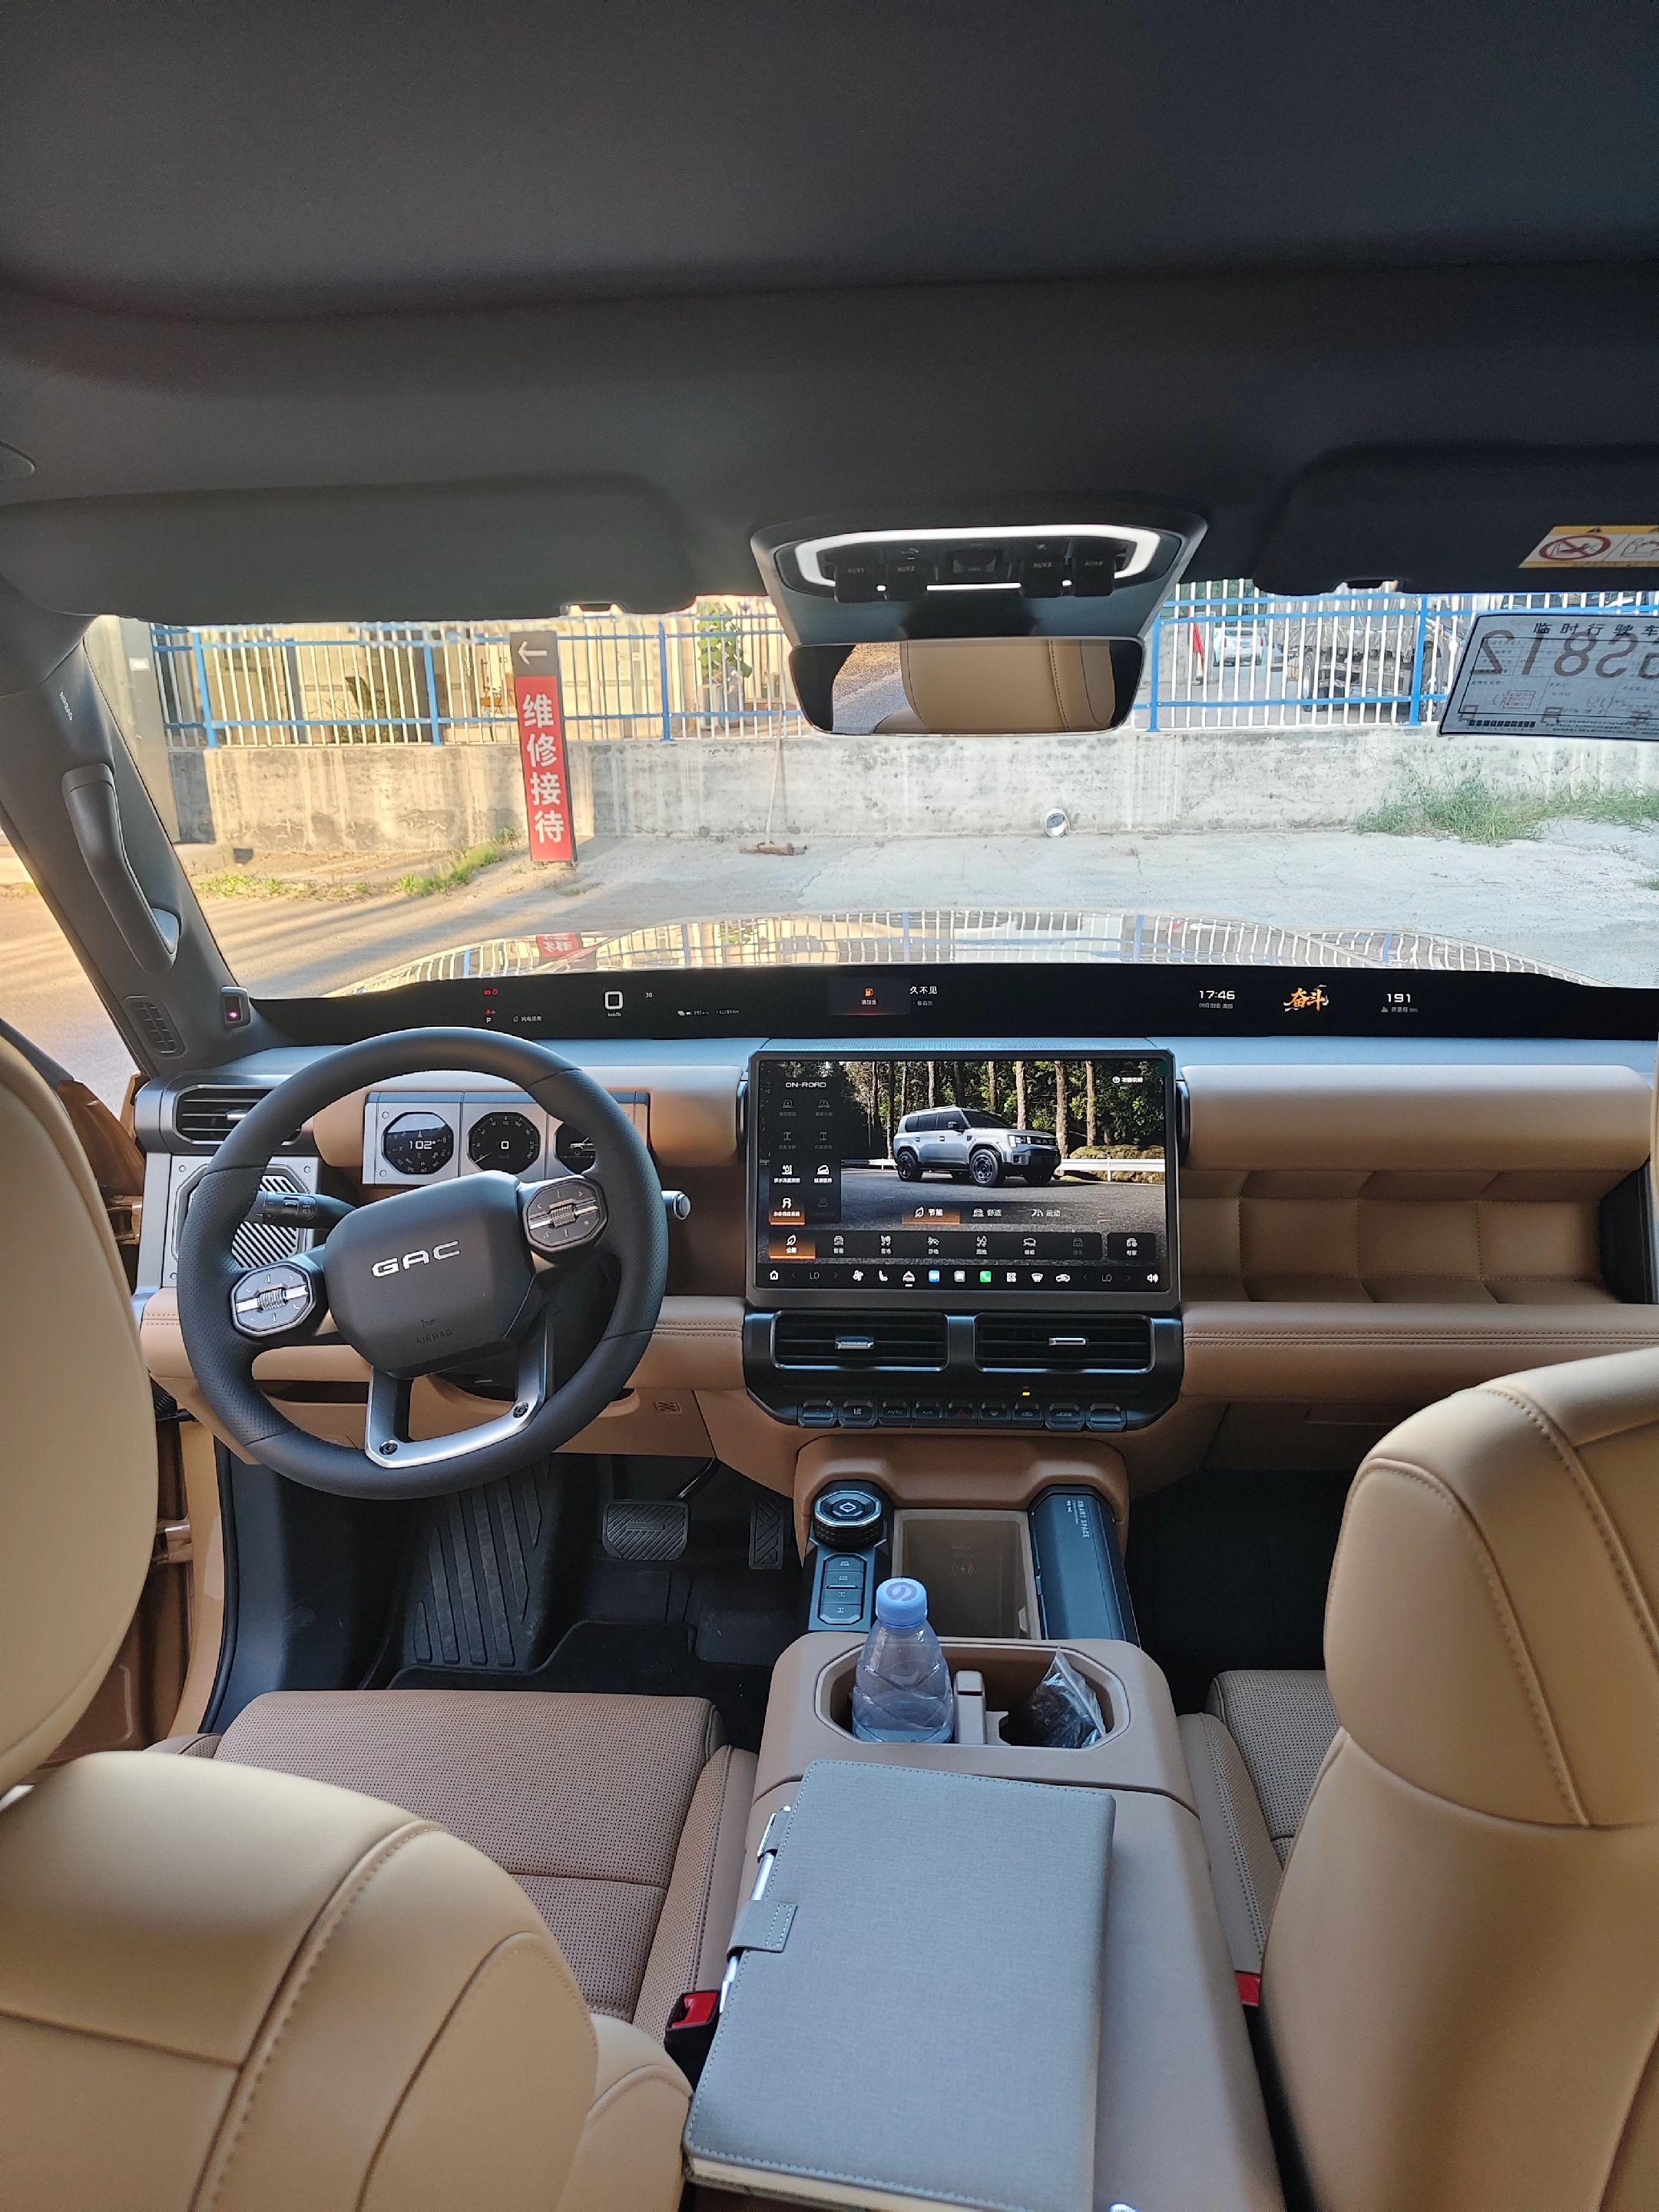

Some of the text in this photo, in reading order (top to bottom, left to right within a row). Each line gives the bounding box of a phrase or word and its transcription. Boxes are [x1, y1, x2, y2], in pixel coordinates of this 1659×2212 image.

[1533, 622, 1659, 637] 临时行驶车
[523, 694, 565, 843] 维修接待
[909, 985, 938, 995] 久不见
[1199, 990, 1236, 1000] 17:46
[604, 991, 624, 1010] 0
[1289, 985, 1327, 1012] 奋斗
[1386, 993, 1412, 1003] 191
[409, 1140, 436, 1150] 102°
[501, 1140, 509, 1150] 0
[928, 1208, 943, 1217] 节能
[987, 1209, 1002, 1217] 舒适
[372, 1241, 460, 1277] GAC
[416, 1329, 453, 1346] AIRBAG
[1077, 1499, 1090, 1538] SMART SPACE
